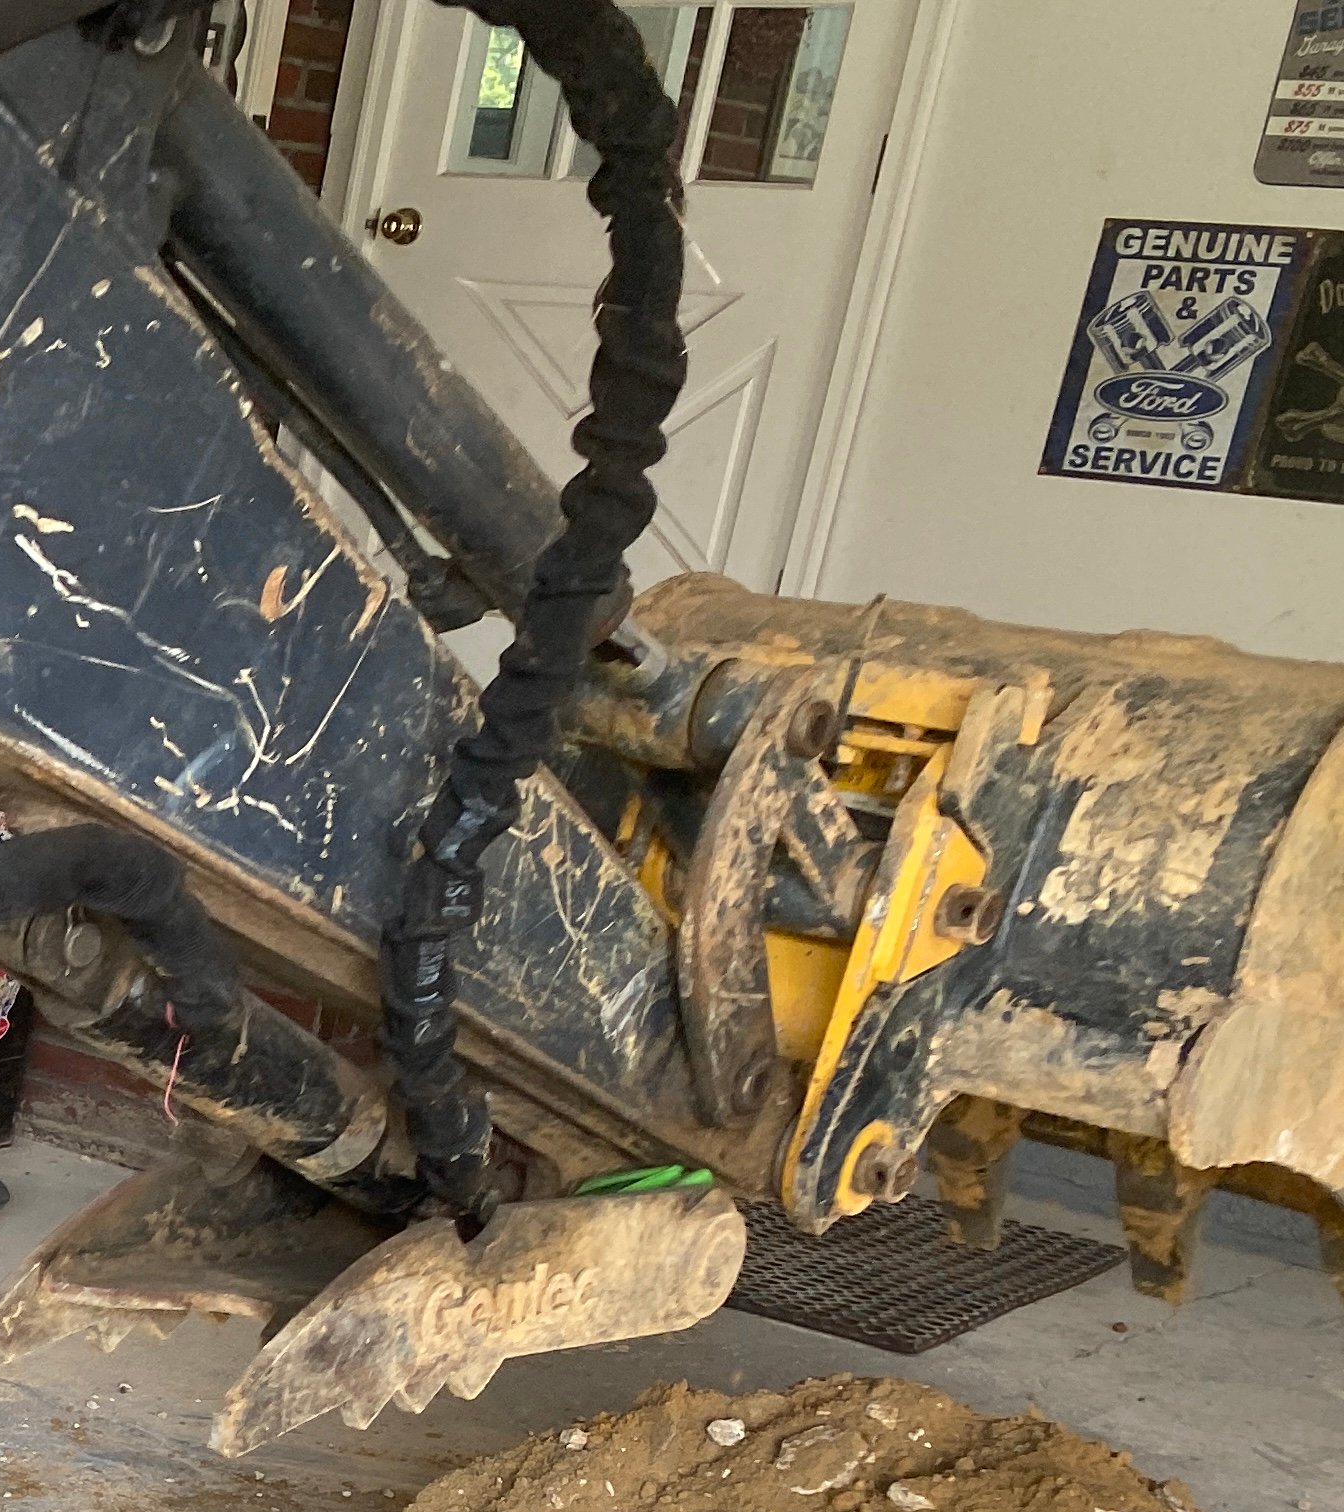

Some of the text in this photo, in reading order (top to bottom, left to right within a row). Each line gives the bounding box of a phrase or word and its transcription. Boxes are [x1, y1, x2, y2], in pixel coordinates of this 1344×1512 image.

[1115, 227, 1297, 265] GENUINE
[1141, 264, 1257, 296] PARTS
[1176, 296, 1198, 320] &
[1119, 379, 1203, 414] Ford
[1068, 444, 1221, 481] SERVICE
